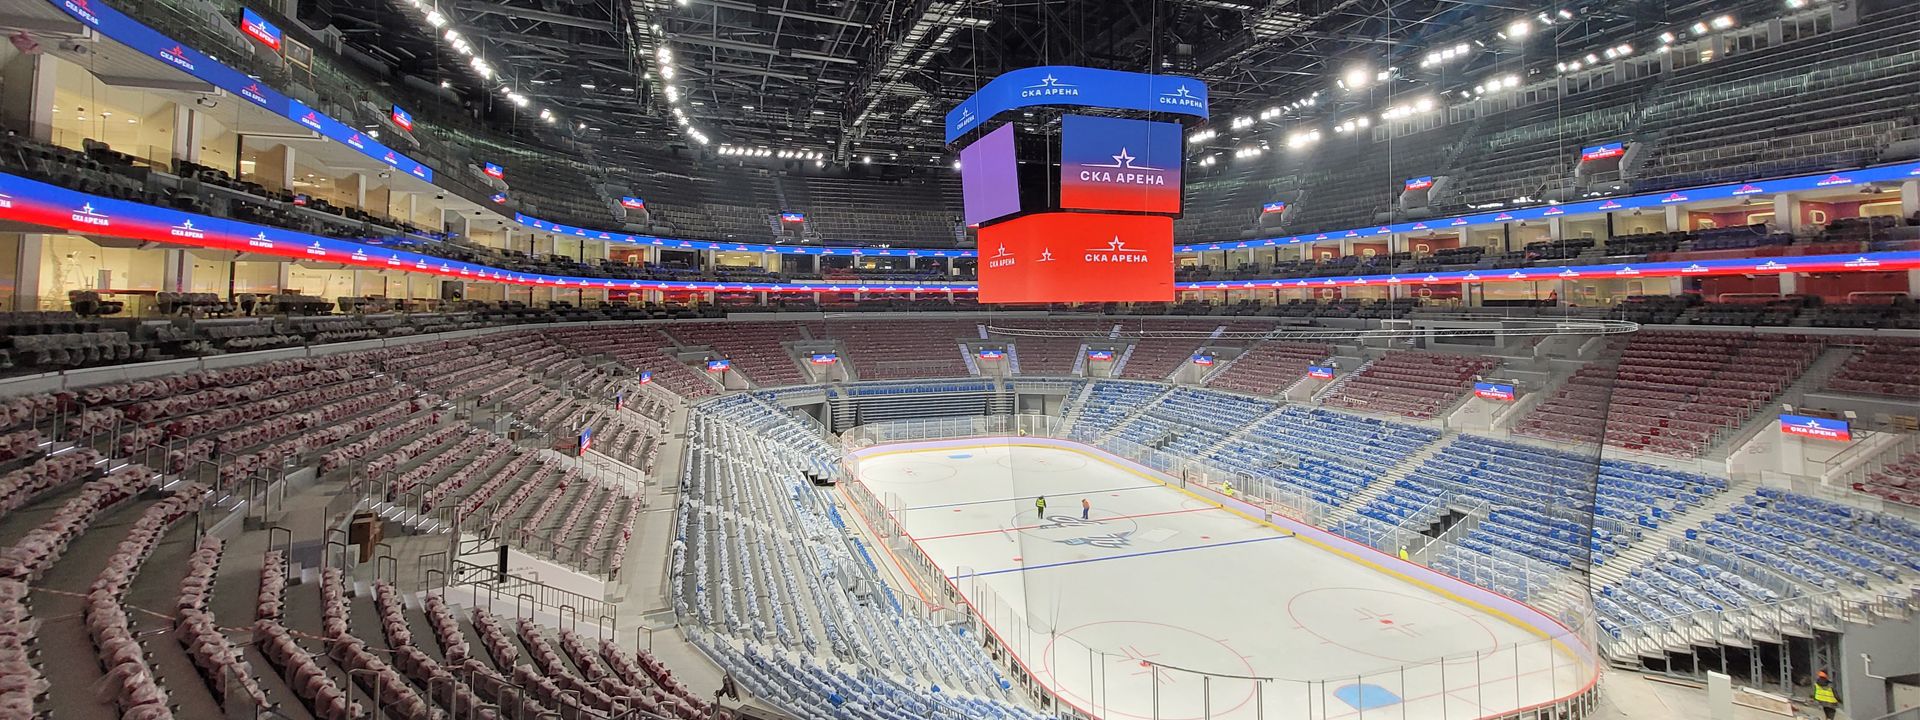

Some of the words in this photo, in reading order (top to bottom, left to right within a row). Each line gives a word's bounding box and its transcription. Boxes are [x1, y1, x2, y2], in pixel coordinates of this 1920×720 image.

[160, 51, 173, 61] СКА
[173, 57, 194, 70] АРЕНА
[1180, 98, 1202, 108] АРЕНА
[1080, 171, 1111, 182] СКА
[1116, 173, 1164, 185] АРЕНА
[84, 216, 109, 226] АРЕНА
[990, 260, 998, 268] СКА
[1000, 258, 1015, 267] АРЕНА
[1085, 254, 1108, 262] СКА
[1112, 254, 1148, 262] АРЕНА
